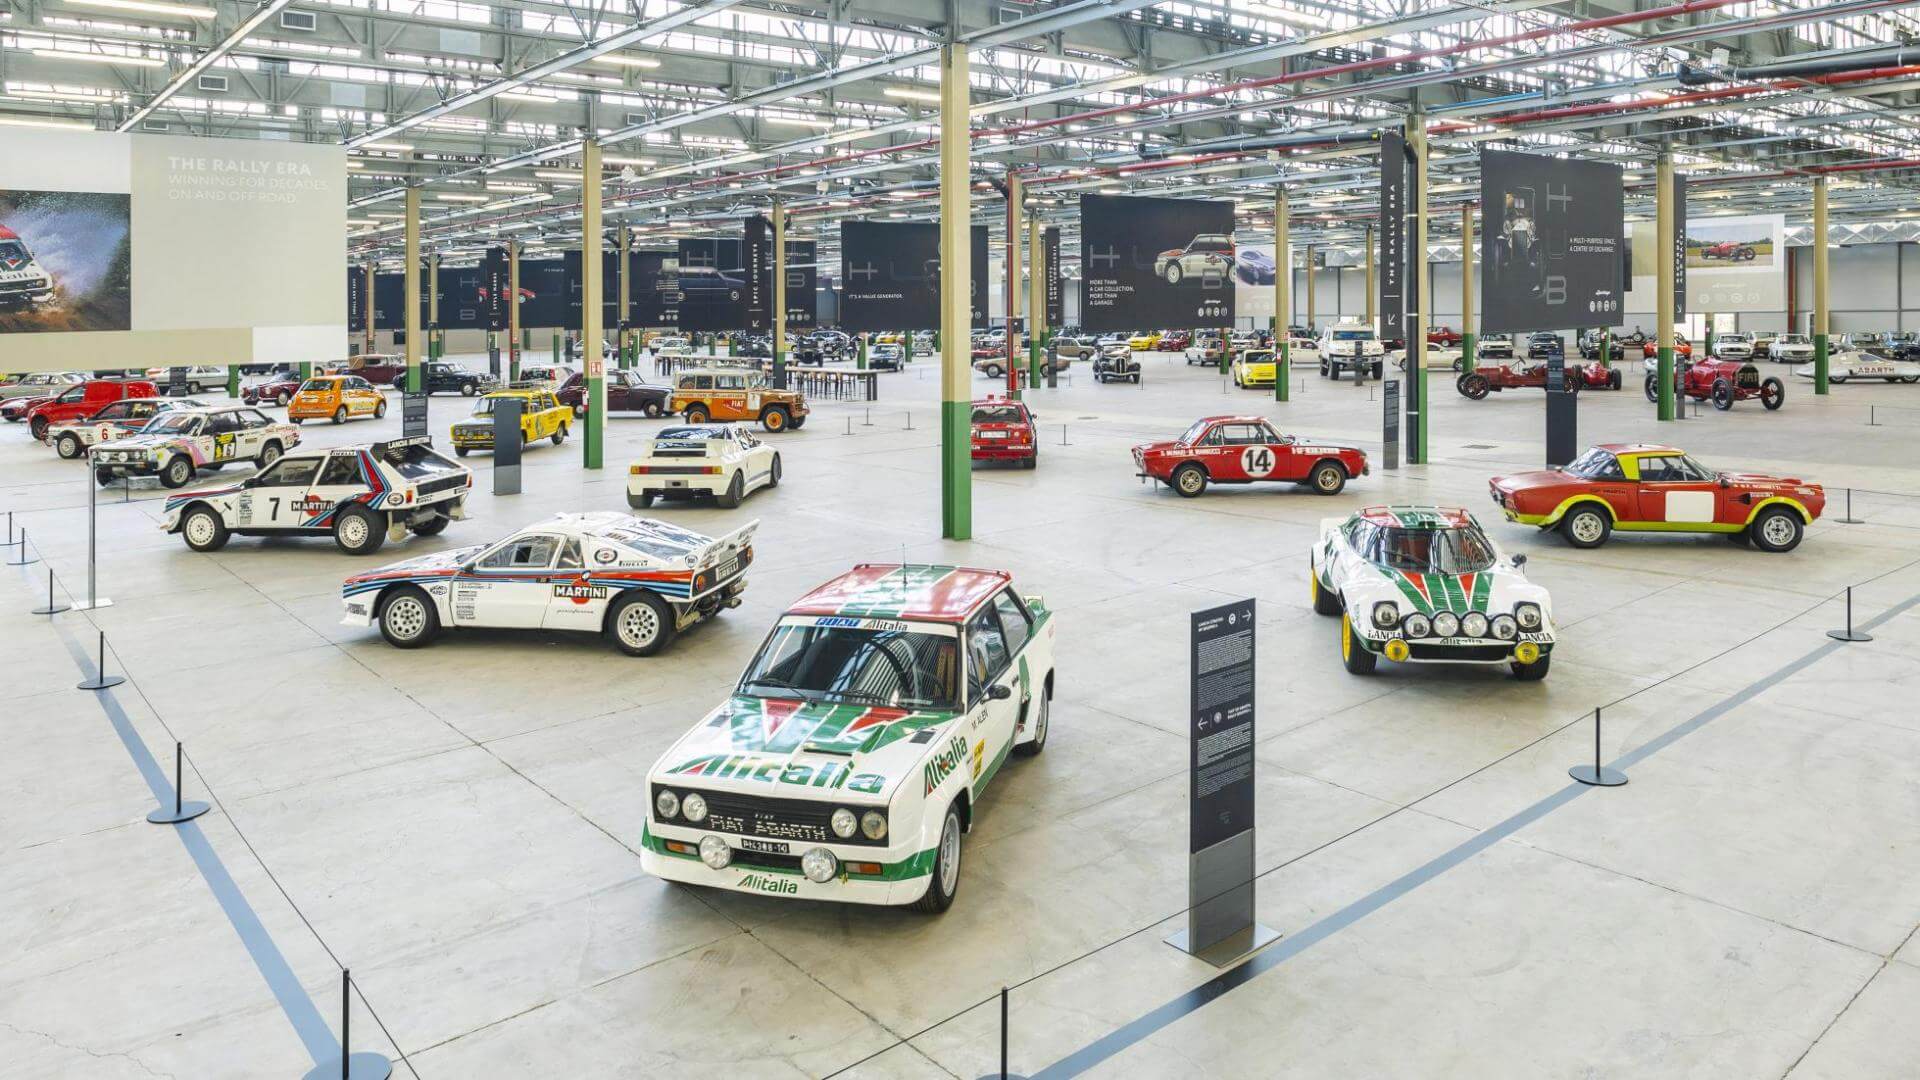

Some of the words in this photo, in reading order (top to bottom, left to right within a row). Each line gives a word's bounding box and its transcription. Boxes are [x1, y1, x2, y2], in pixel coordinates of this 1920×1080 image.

[168, 155, 207, 171] THE
[213, 157, 271, 174] RALLY
[277, 160, 312, 176] ERA
[168, 174, 236, 186] WINNING
[239, 176, 266, 188] FOR
[270, 178, 329, 191] DECADES
[168, 188, 192, 200] ON
[192, 189, 227, 201] AND
[1738, 372, 1758, 383] FIAT
[1857, 366, 1895, 374] ABARTH
[101, 428, 109, 441] 6
[387, 440, 407, 450] LANCIA
[1245, 449, 1271, 472] 14
[269, 497, 280, 520] 7
[556, 586, 607, 598] MARTINI
[815, 617, 861, 628] FIAT
[863, 618, 909, 632] Alitalia
[665, 753, 887, 795] Alitalia
[923, 734, 969, 800] Alitalia
[709, 813, 745, 832] FIAT
[754, 820, 827, 841] ABARTH
[736, 874, 799, 894] Alitalia
